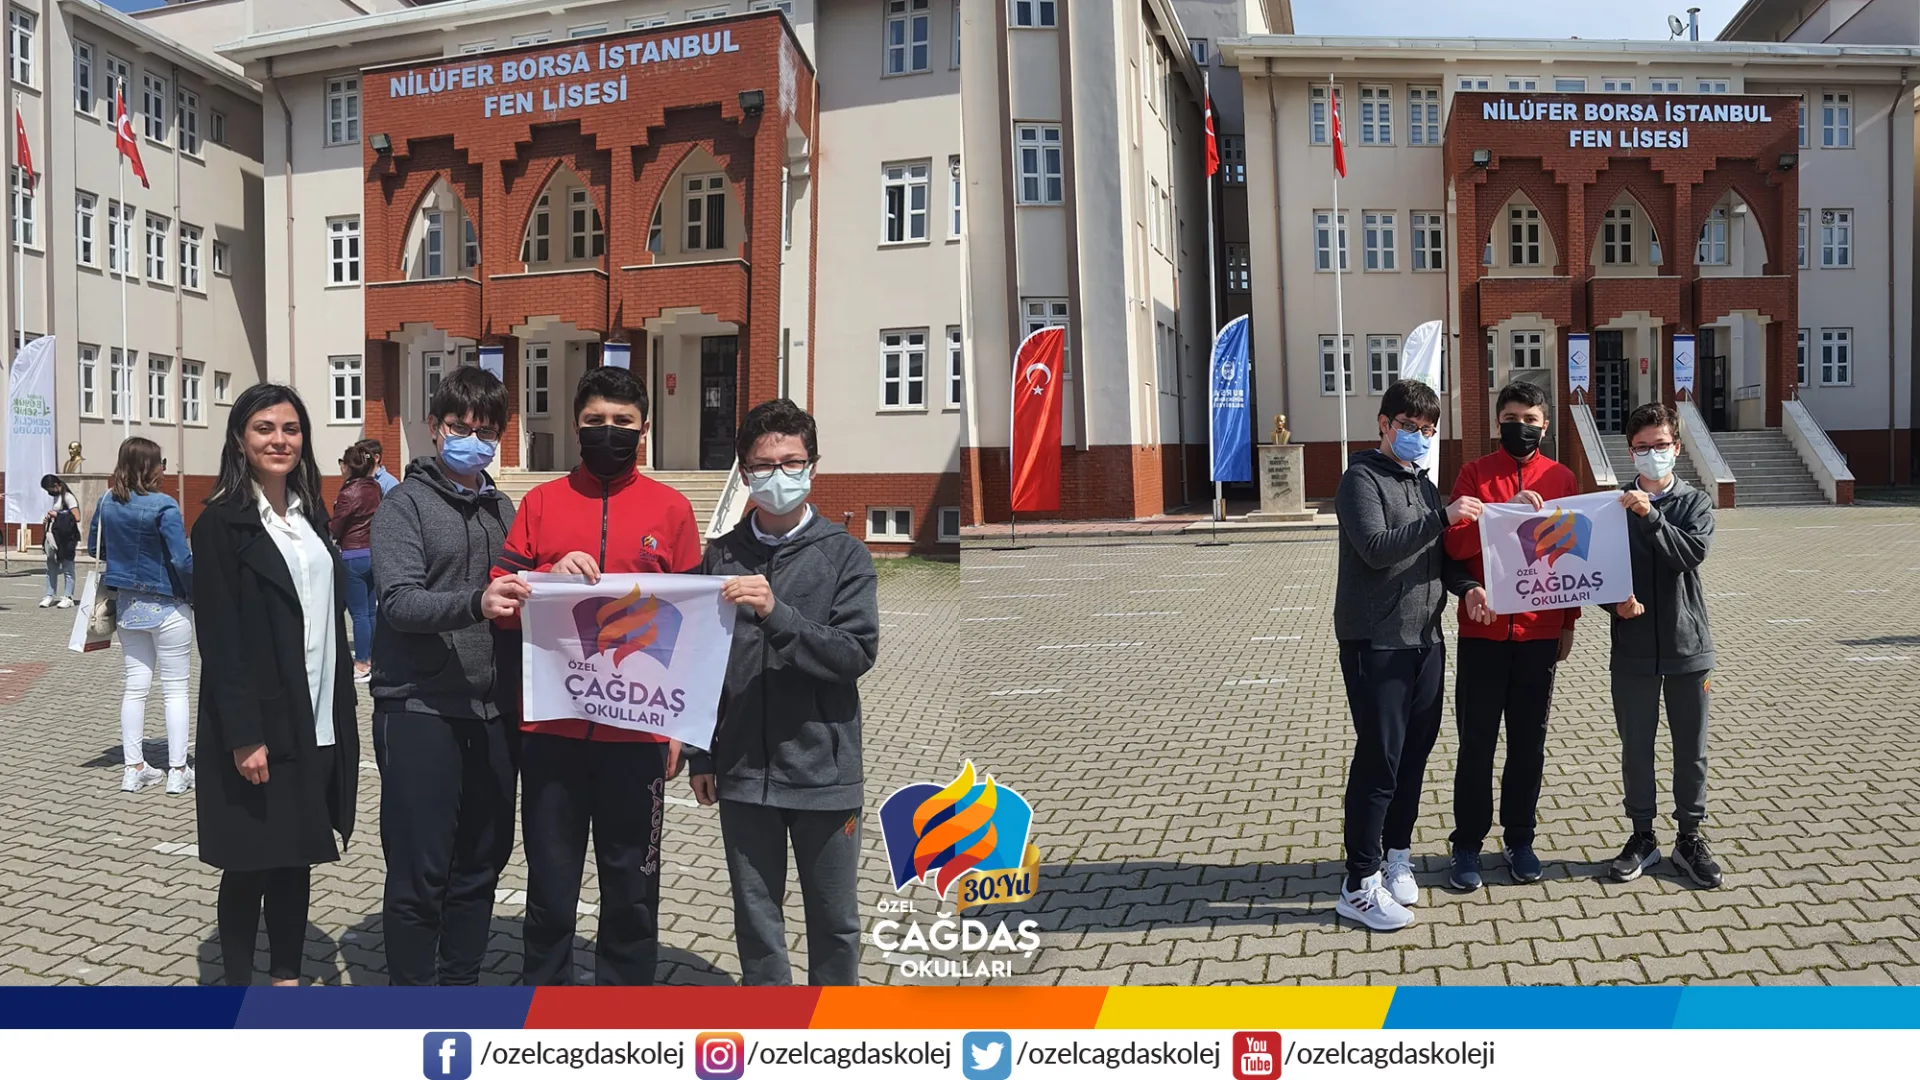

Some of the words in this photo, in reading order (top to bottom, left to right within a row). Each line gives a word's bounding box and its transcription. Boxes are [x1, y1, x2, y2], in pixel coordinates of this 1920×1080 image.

[390, 63, 494, 98] NİLÜFER
[501, 51, 590, 84] BORSA
[599, 30, 740, 71] İSTANBUL
[484, 91, 533, 118] FEN
[543, 75, 628, 111] LİSESİ
[1483, 99, 1578, 121] NİLÜFER
[1584, 103, 1659, 122] BORSA
[1665, 101, 1772, 122] İSTANBUL
[1569, 130, 1612, 148] FEN
[1620, 127, 1688, 149] LİSESİ
[1516, 568, 1538, 577] ÖZEL
[1515, 571, 1604, 600] ÇAĞDAŞ
[1531, 591, 1590, 607] OKULLARI
[568, 659, 597, 672] ÖZEL
[564, 674, 686, 717] ÇAĞDAŞ
[584, 702, 665, 727] OKULLARI
